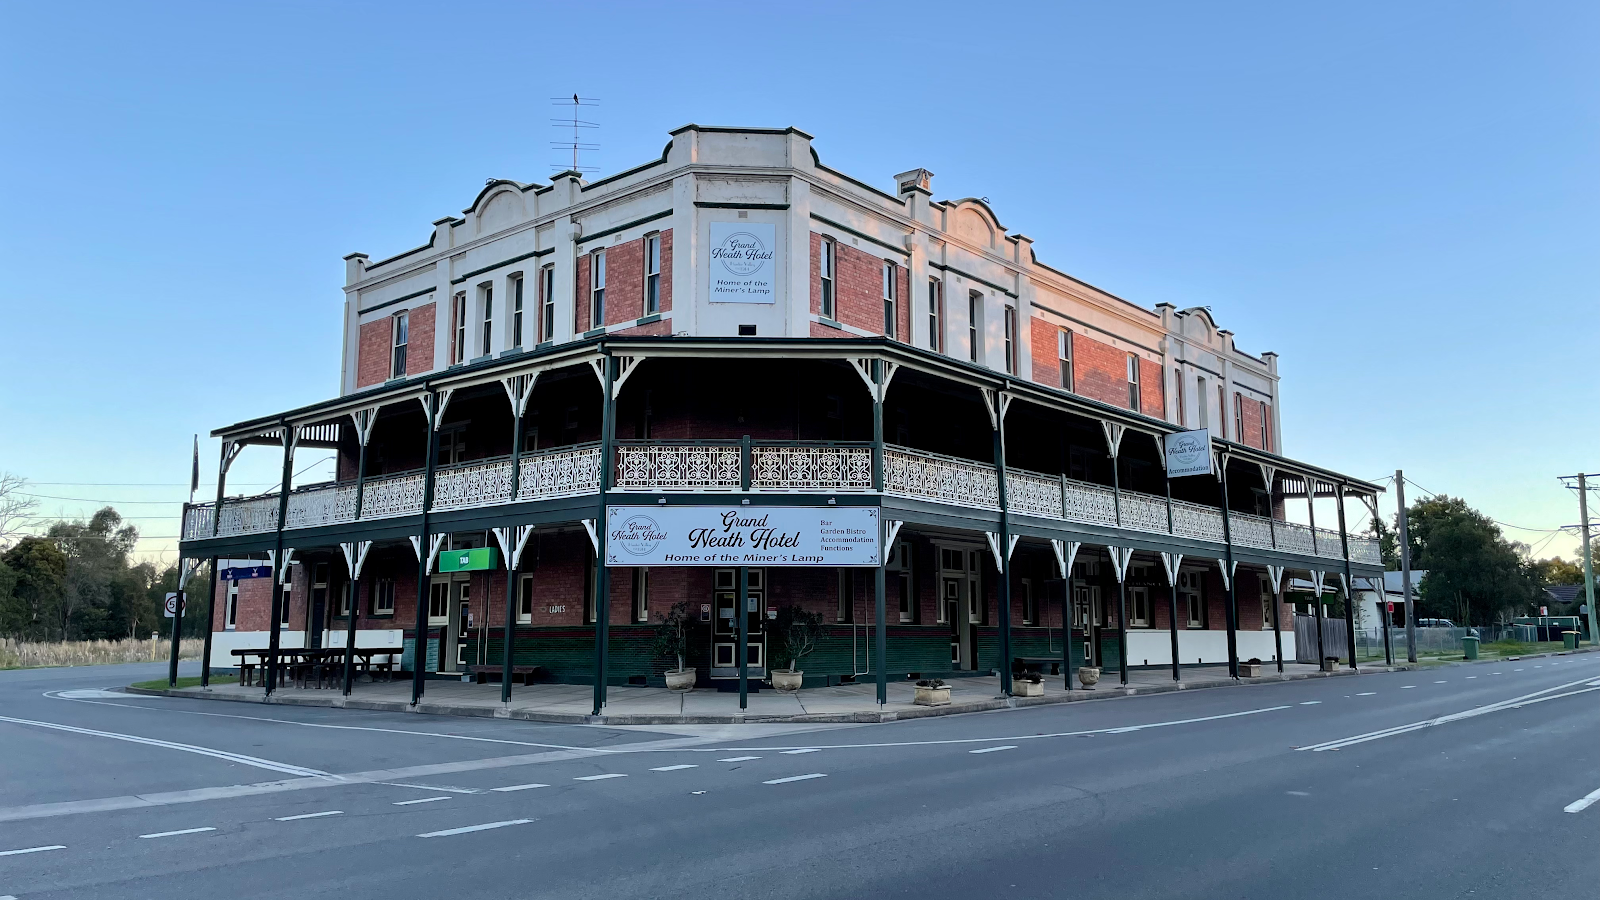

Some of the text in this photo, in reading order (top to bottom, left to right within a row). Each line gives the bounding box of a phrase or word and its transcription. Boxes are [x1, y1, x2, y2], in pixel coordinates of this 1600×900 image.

[730, 239, 756, 251] Grand
[712, 247, 773, 260] Neath Hotel
[747, 287, 770, 295] Lamp
[1179, 440, 1195, 449] Grand
[1188, 444, 1206, 453] Hotel
[1168, 465, 1209, 475] Accommodation
[628, 521, 652, 533] Grand
[720, 510, 769, 533] Grand
[611, 530, 668, 541] Neath Hotel
[688, 527, 801, 550] Neath Hotel
[664, 553, 824, 564] Home of the Miner's Lamp
[549, 604, 566, 614] LADIES
